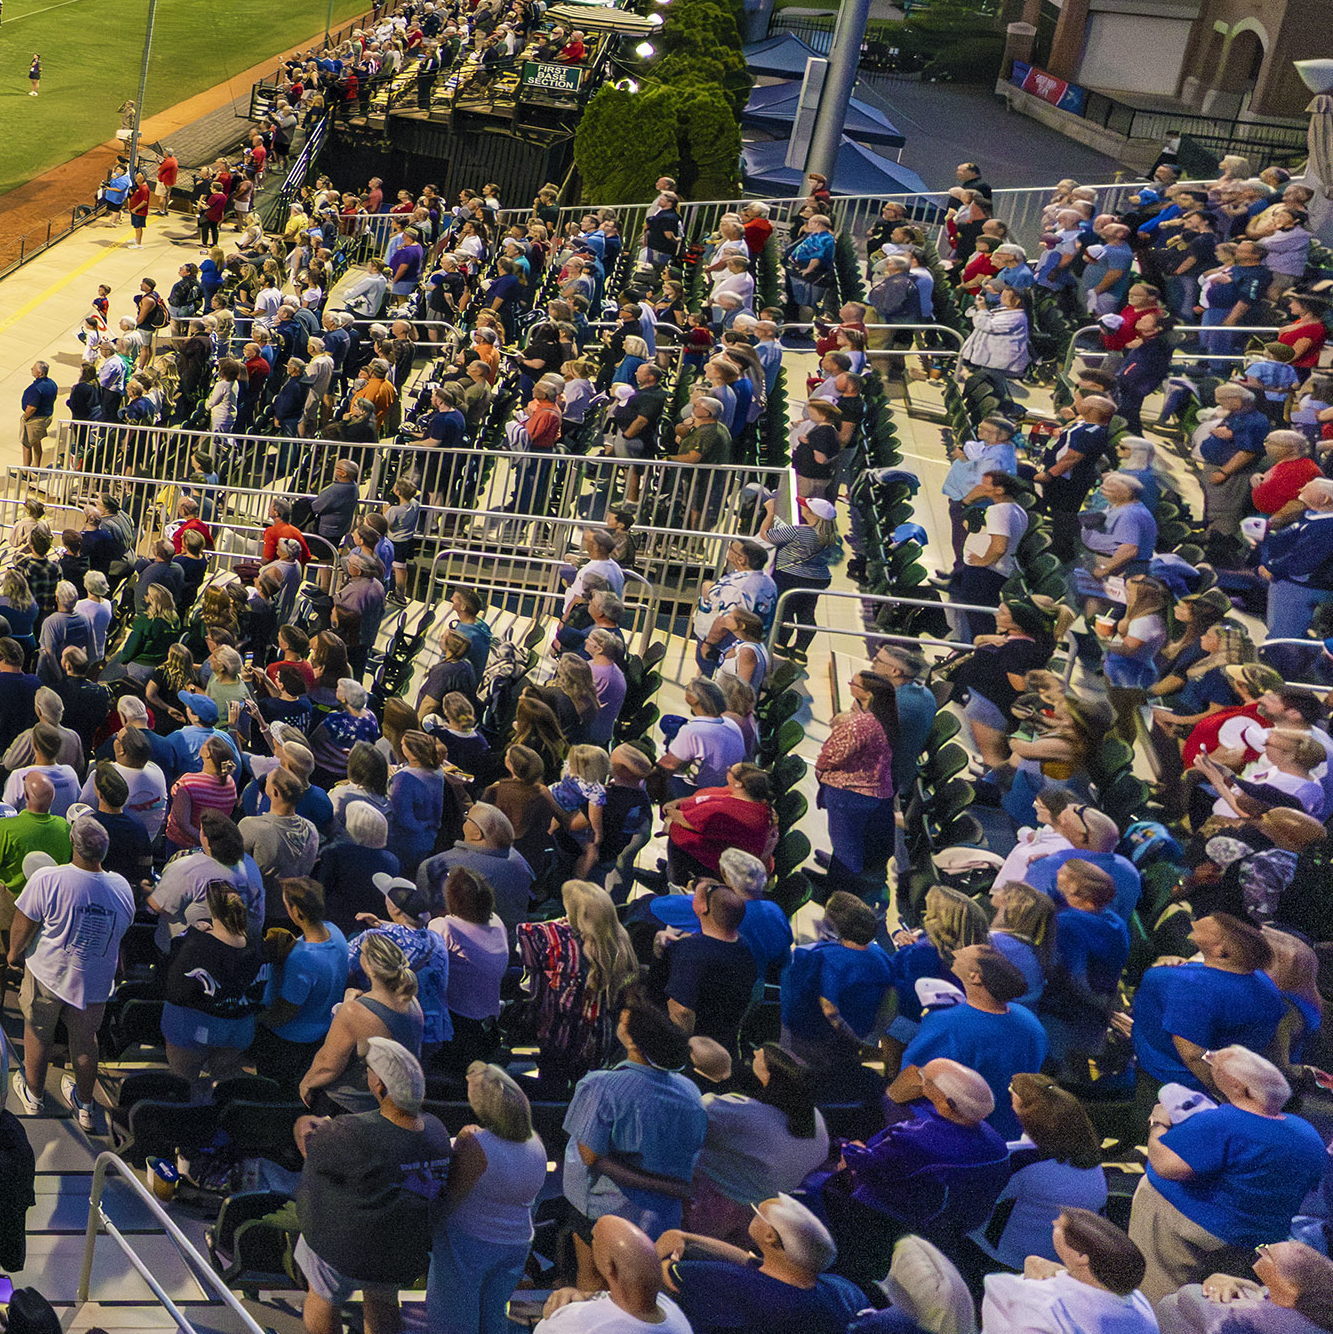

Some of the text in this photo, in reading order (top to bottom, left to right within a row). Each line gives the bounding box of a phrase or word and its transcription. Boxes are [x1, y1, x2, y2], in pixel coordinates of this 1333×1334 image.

[538, 65, 568, 75] FIRST
[537, 72, 566, 81] BASE
[528, 77, 573, 89] SECTION
